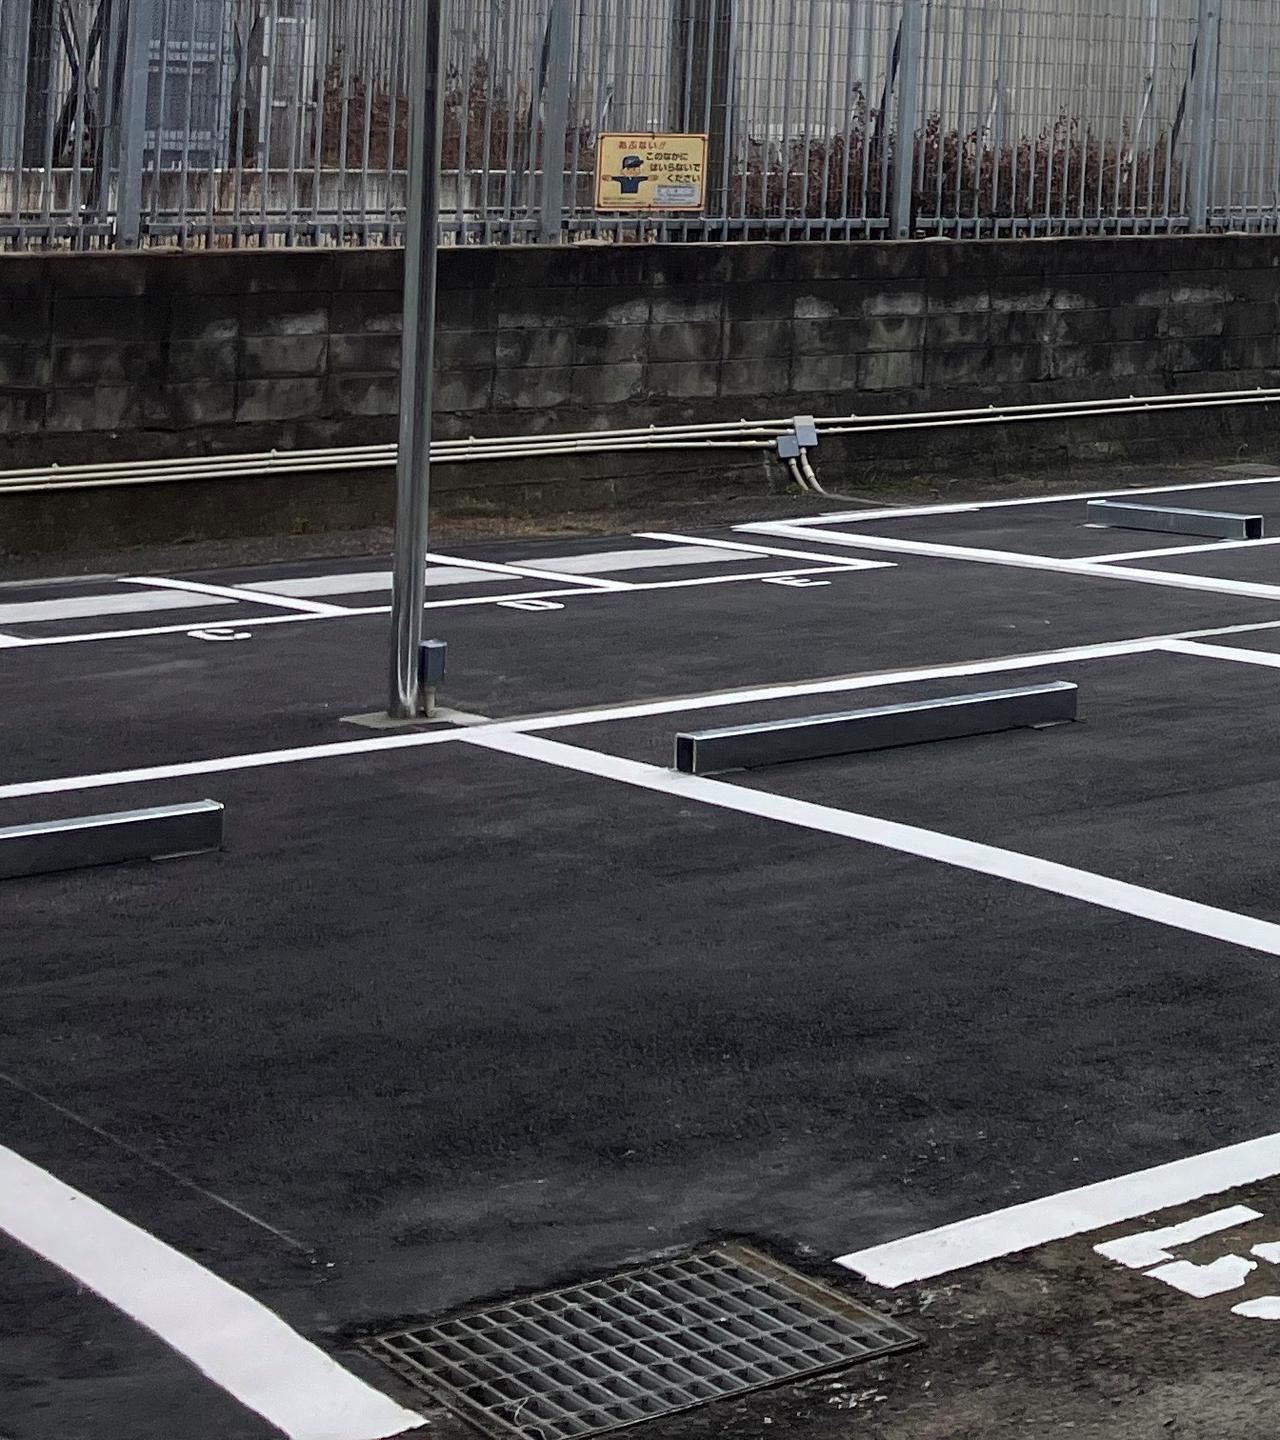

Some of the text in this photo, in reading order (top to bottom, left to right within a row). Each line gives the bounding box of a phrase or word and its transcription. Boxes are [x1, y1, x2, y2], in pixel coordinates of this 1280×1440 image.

[646, 152, 688, 161] このなかに
[650, 163, 701, 172] はいらないで
[667, 174, 701, 183] ください
